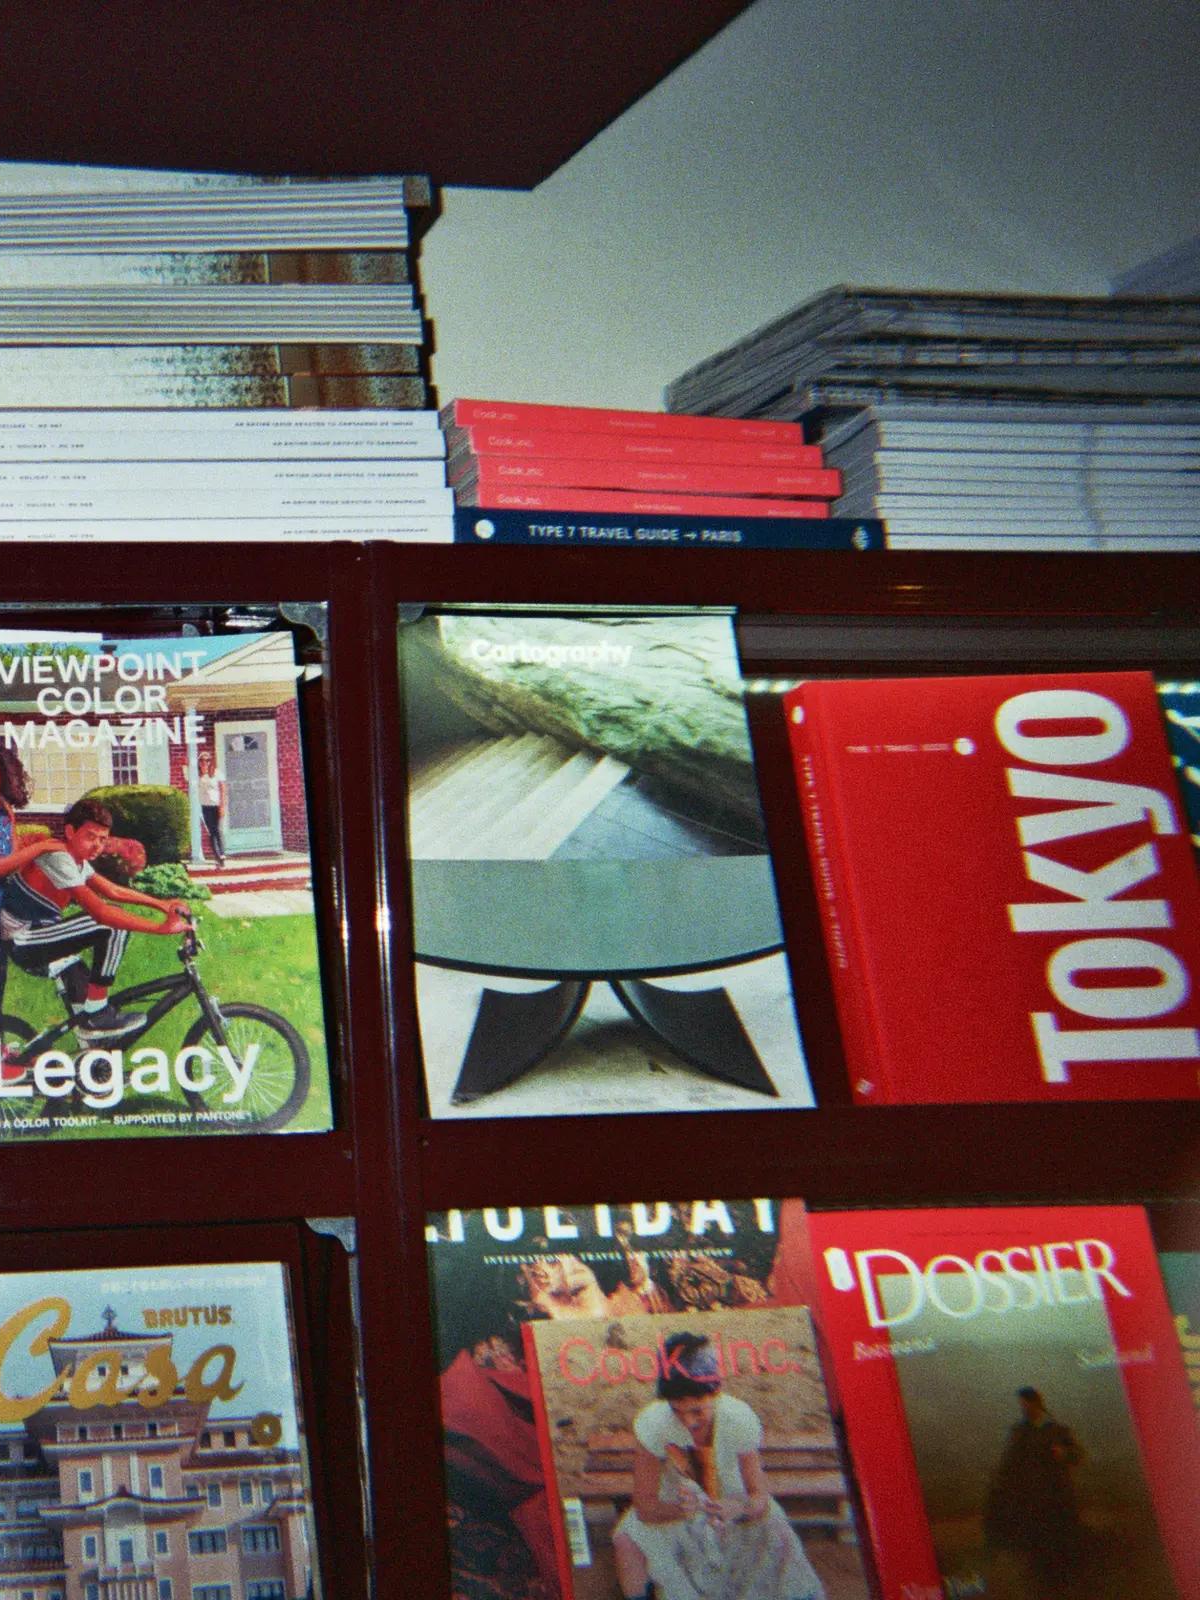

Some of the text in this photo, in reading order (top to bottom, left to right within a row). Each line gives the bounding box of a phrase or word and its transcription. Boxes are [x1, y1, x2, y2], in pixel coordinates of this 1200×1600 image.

[528, 525, 742, 543] TYPE 7 TRAVEL GUIDE PARIS
[471, 639, 633, 668] Cartography
[36, 685, 169, 717] COLOR
[4, 715, 206, 750] MAGAZINE
[13, 1118, 50, 1128] COLOR
[54, 1116, 98, 1127] TOOLKIT
[113, 1113, 176, 1125] SUPPORTED
[179, 1112, 192, 1123] BY
[854, 1239, 1132, 1329] DOSSIER
[142, 1304, 233, 1329] BRUTUS
